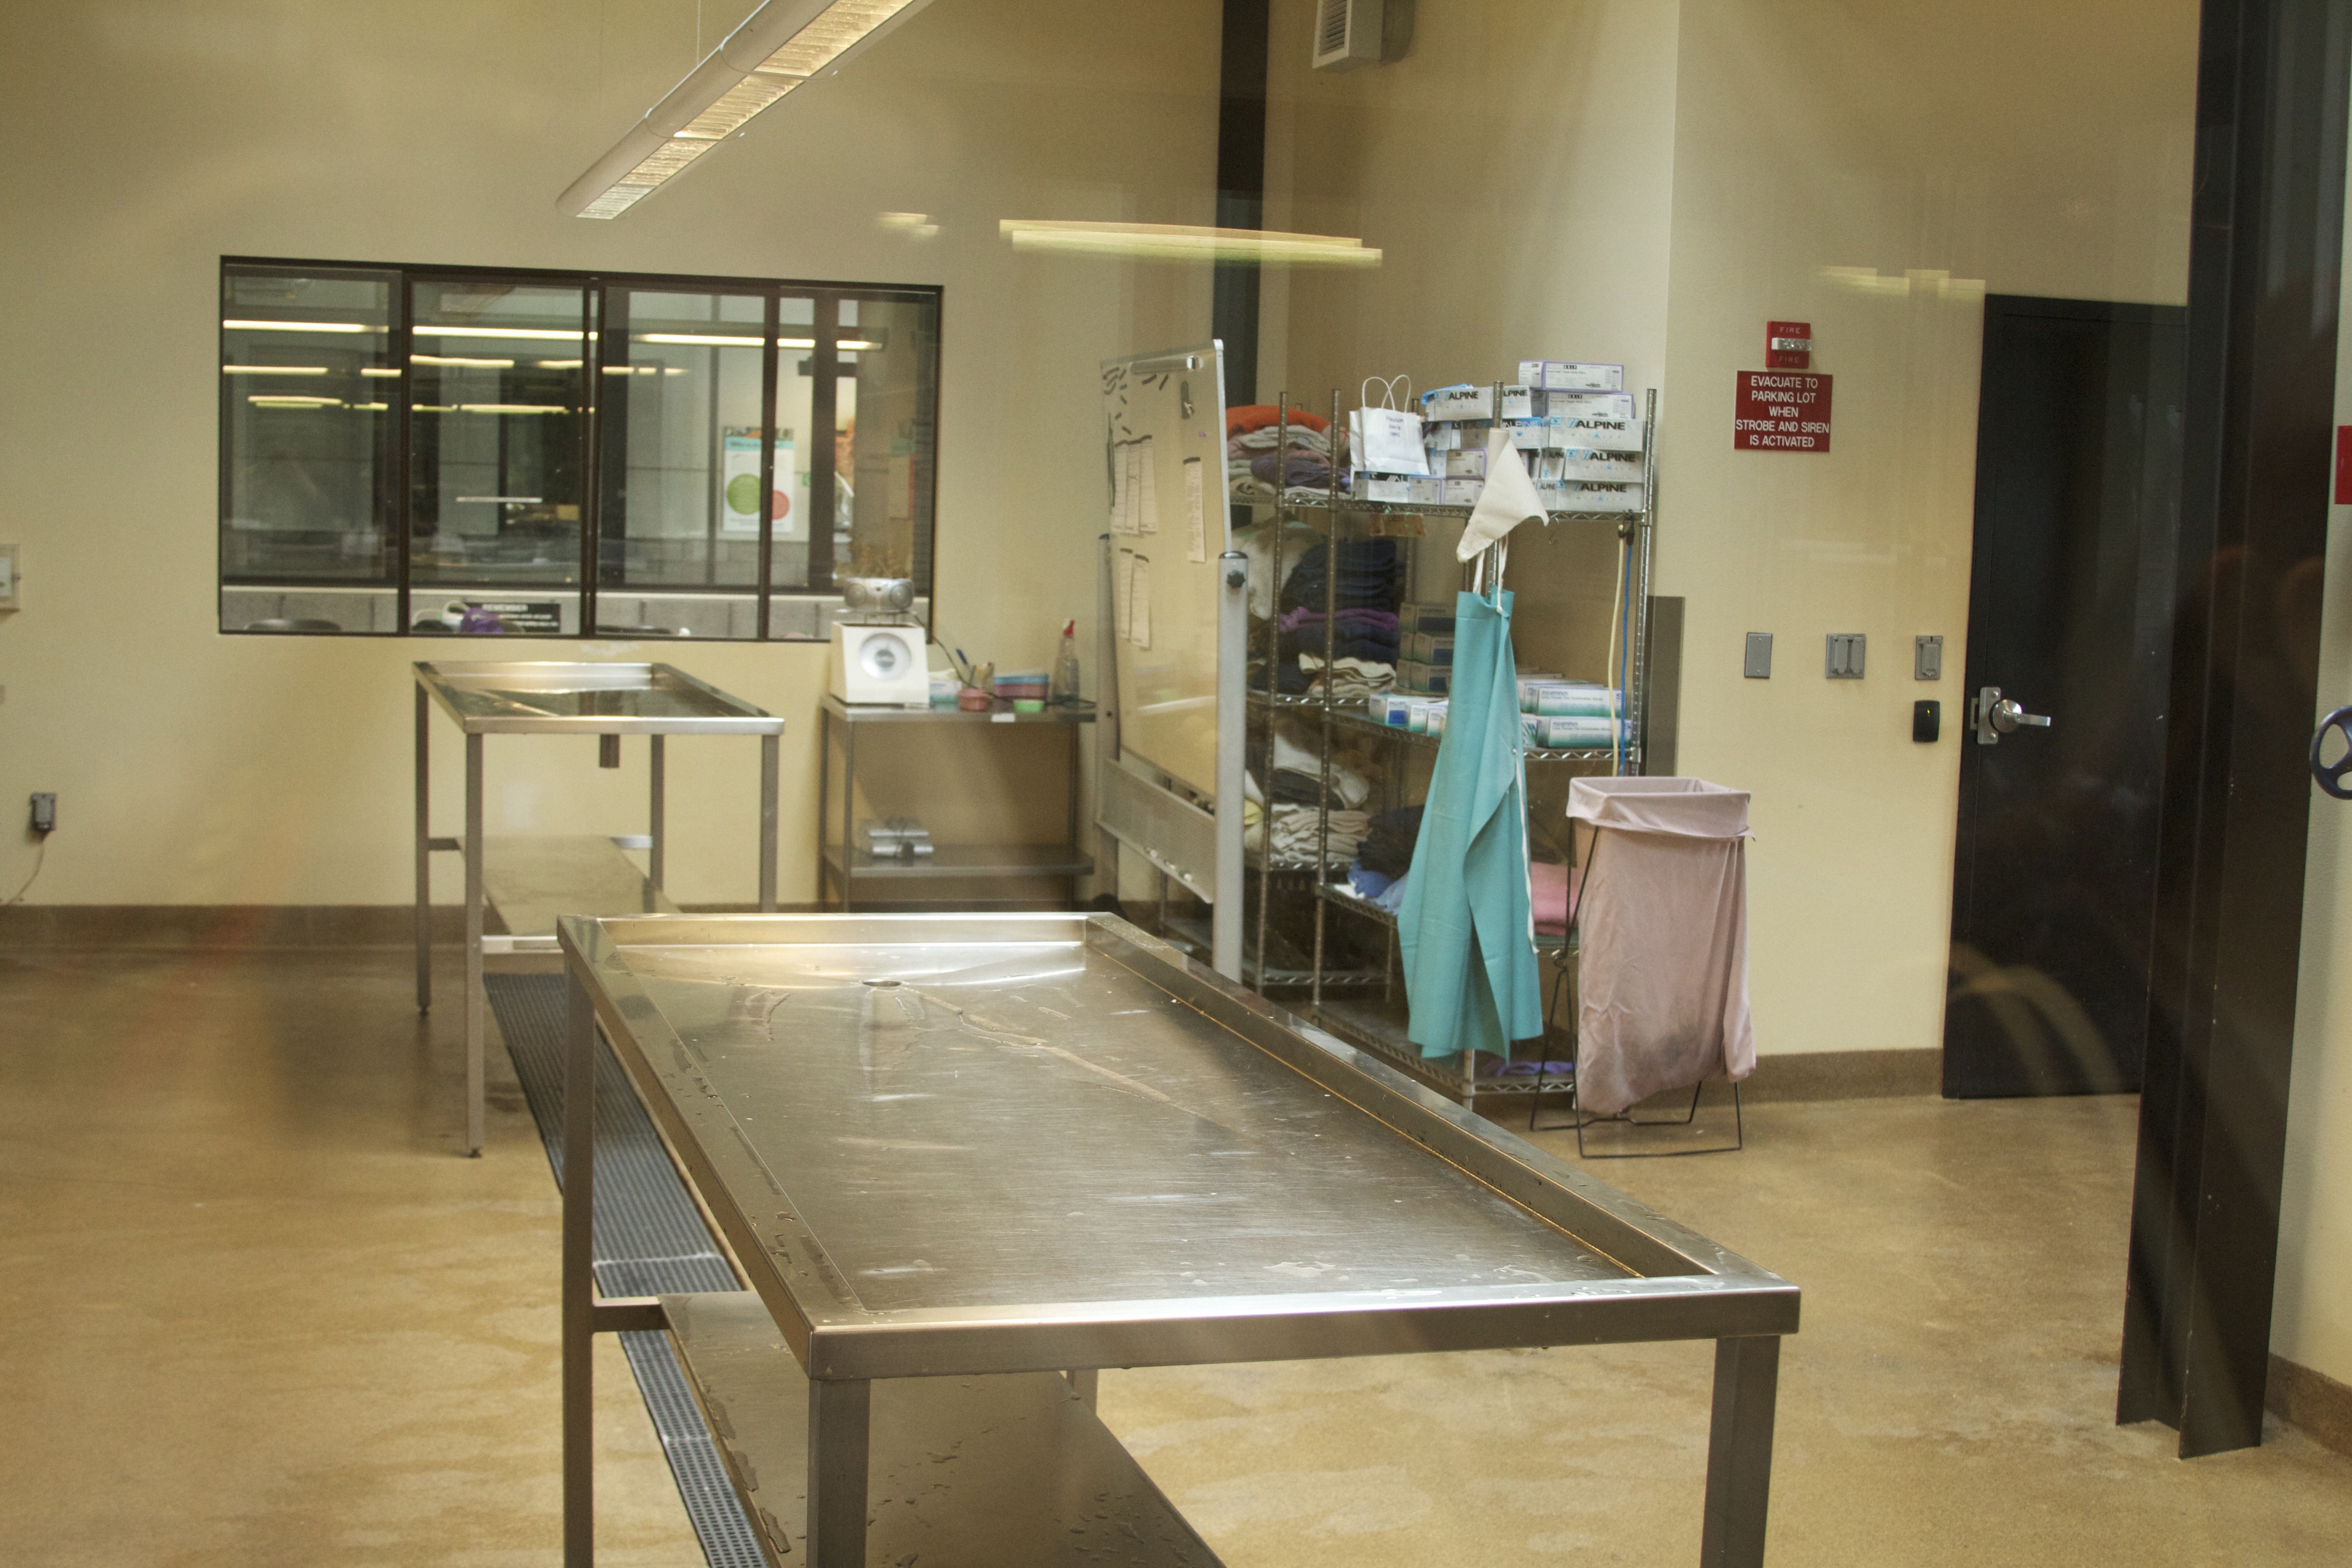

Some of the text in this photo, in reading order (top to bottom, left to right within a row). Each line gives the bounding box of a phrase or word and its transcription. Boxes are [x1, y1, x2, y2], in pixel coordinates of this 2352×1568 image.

[1750, 376, 1818, 389] EVACUATE TO
[1449, 391, 1479, 400] ALPINE
[1751, 391, 1816, 403] PARKING LOT
[1769, 406, 1799, 418] WHEN
[1575, 420, 1626, 431] ALPINE
[1736, 419, 1829, 434] STROBE AND SIREN
[1749, 435, 1815, 447] IS ACTIVATED
[1590, 452, 1636, 463] ALPINE
[1580, 483, 1627, 493] ALPINE
